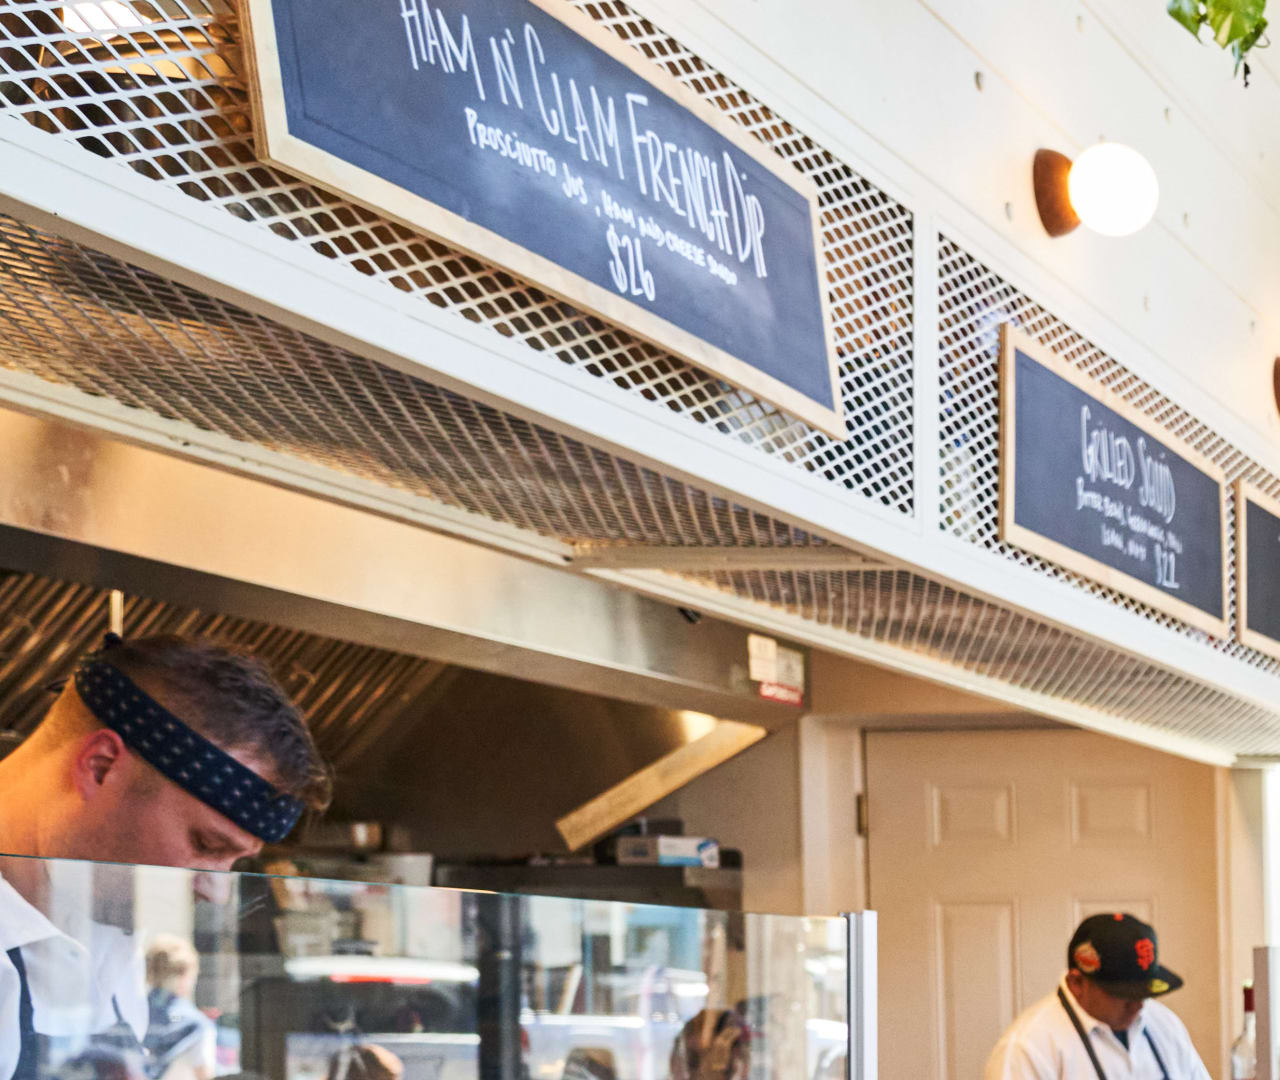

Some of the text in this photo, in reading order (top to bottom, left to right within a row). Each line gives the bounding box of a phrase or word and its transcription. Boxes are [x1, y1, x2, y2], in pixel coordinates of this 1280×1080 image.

[400, 0, 486, 101] HAM
[524, 22, 625, 180] CLAM
[626, 93, 732, 255] FRENCH
[606, 223, 656, 301] $26
